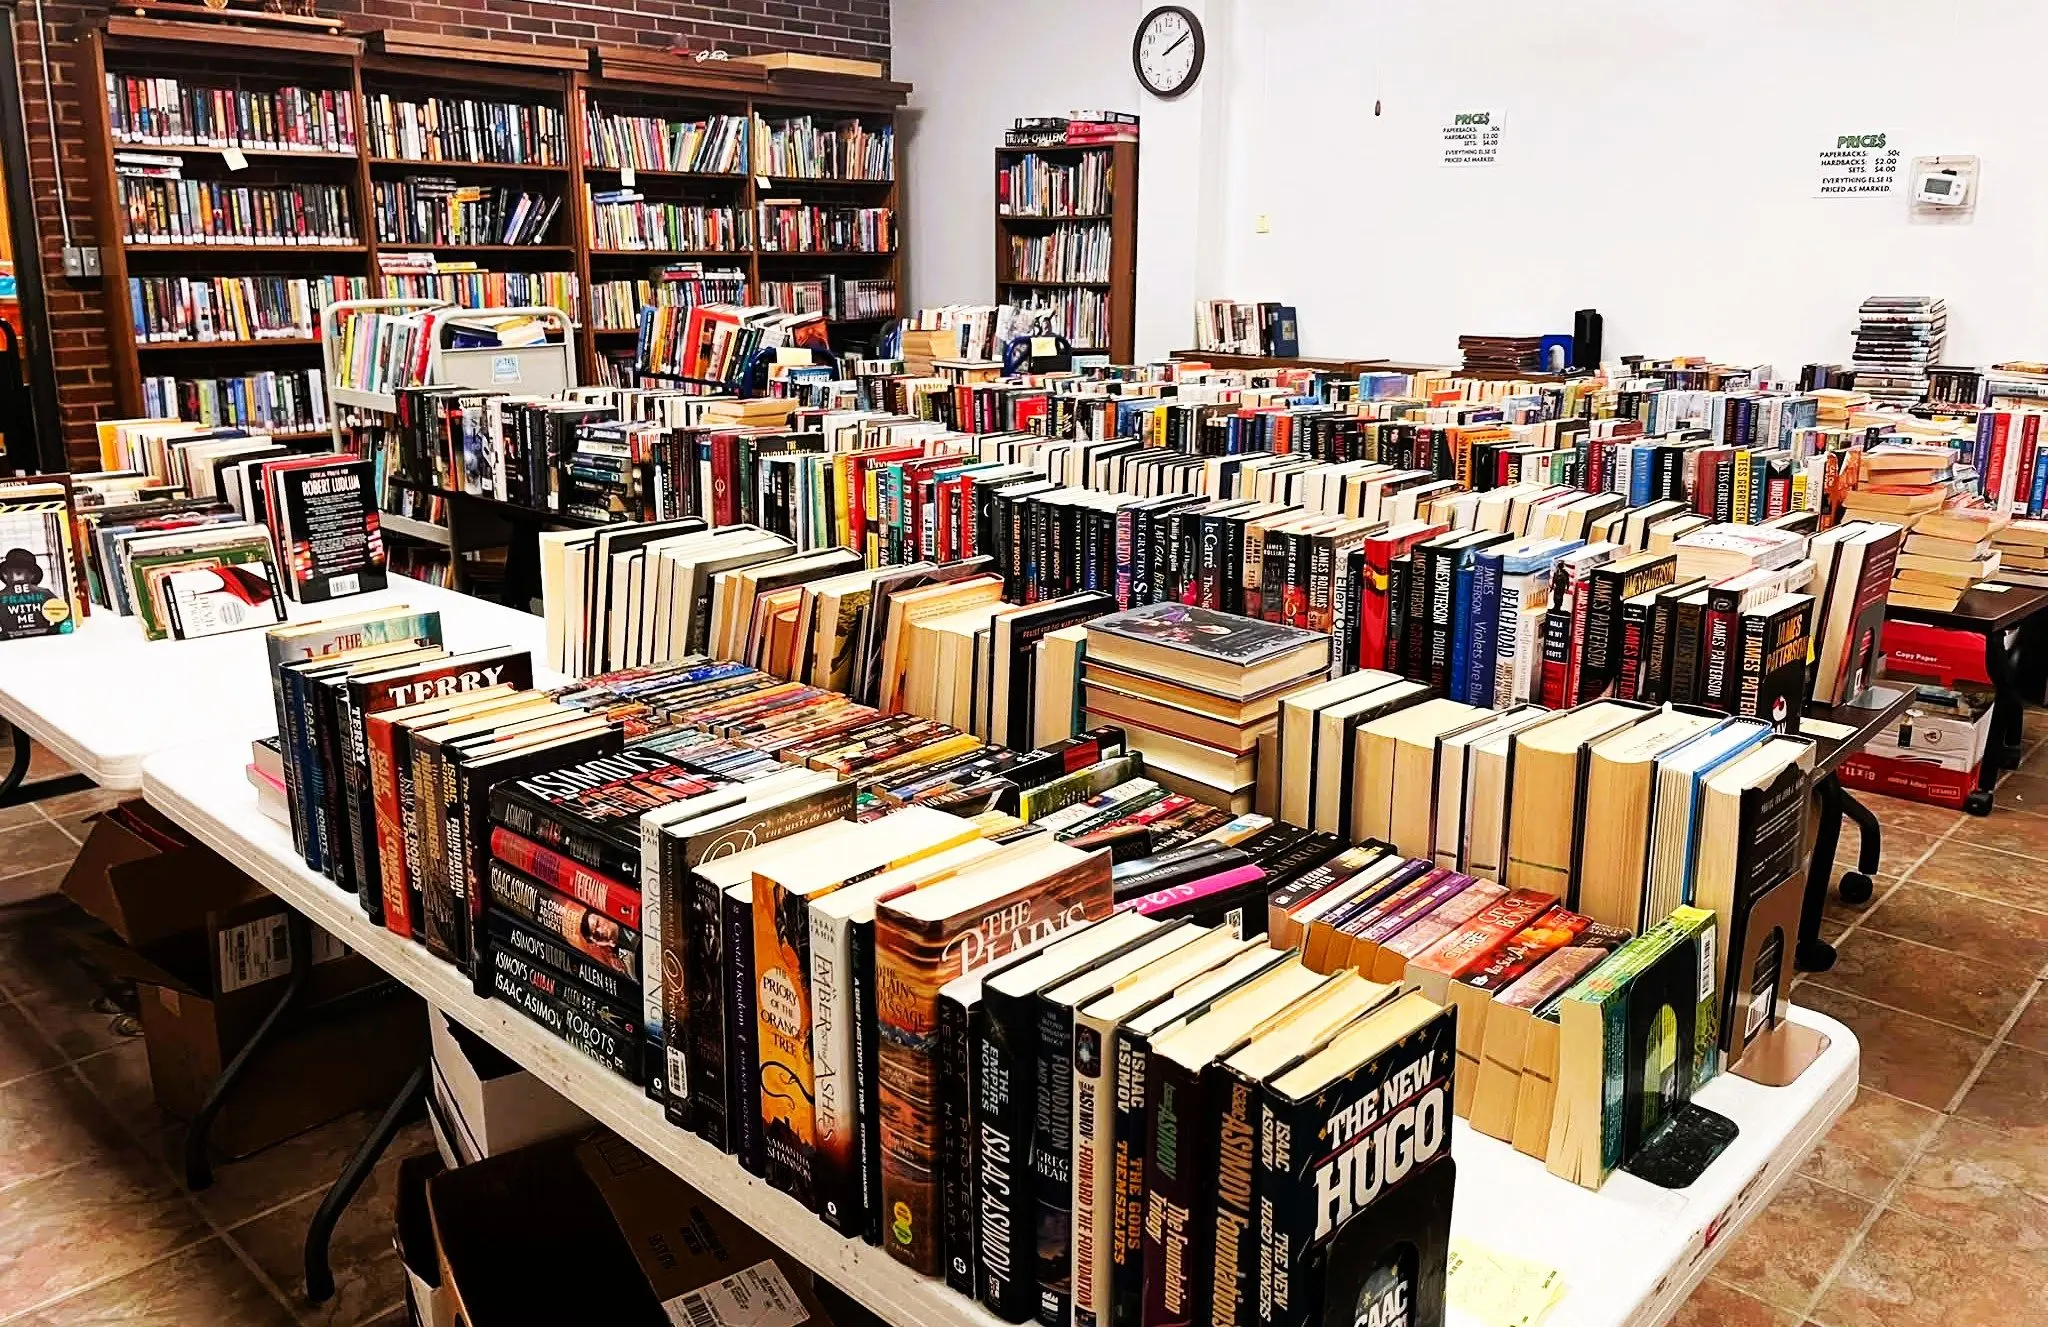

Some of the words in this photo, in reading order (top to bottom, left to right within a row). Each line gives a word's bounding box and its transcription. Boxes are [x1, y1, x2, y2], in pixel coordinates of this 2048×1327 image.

[302, 478, 331, 497] ROBERT
[332, 474, 362, 493] LUDLUM
[1458, 448, 1468, 482] HARLAN
[1737, 458, 1748, 477] TESS
[904, 498, 912, 534] ROBB
[1118, 510, 1132, 526] SUE
[1138, 512, 1146, 531] SUE
[1718, 482, 1729, 522] GERRITSEN
[1735, 479, 1748, 523] GERRITSEN
[1116, 526, 1131, 567] GRAFTON
[1154, 524, 1165, 546] LAST
[1204, 522, 1218, 533] le
[1136, 532, 1146, 580] GRAFTON
[1154, 545, 1164, 572] GIRL
[1204, 534, 1218, 569] Carré
[1253, 538, 1261, 564] JAMES
[1288, 537, 1297, 562] JAMES
[1318, 546, 1330, 573] JAMES
[1412, 550, 1427, 577] JAMES
[1436, 554, 1452, 581] JAMES
[14, 583, 30, 594] BE
[1248, 570, 1256, 588] THE
[1287, 562, 1296, 595] ROLLINS
[1316, 574, 1329, 609] ROLLINS
[1334, 576, 1347, 614] Ellery
[1348, 566, 1357, 601] Agent
[1410, 577, 1426, 618] PATTERSON
[1471, 565, 1484, 615] PATTERSON
[1482, 565, 1496, 596] JAMES
[1576, 588, 1589, 610] JAMES
[1594, 576, 1614, 610] JAMES
[8, 602, 42, 616] WITH
[17, 614, 35, 624] ME
[1432, 580, 1450, 625] PATTERSON
[1500, 588, 1520, 624] BEACH
[1656, 606, 1669, 634] JAMES
[334, 633, 362, 651] THE
[1332, 618, 1346, 663] Queen
[1432, 630, 1446, 666] DOUBLE
[1472, 620, 1488, 658] Violets
[1496, 625, 1518, 659] ROAD
[1546, 640, 1565, 649] COMBAT
[1587, 612, 1611, 668] PATTERSON
[1624, 622, 1641, 657] JAMES
[1712, 618, 1727, 647] JAMES
[1776, 614, 1802, 648] JAMES
[1471, 660, 1482, 682] Are
[1648, 635, 1666, 682] PATTERSON
[1708, 649, 1725, 698] PATTERSON
[1744, 636, 1763, 671] JAMES
[1766, 634, 1810, 675] PATTERSON
[1896, 650, 1915, 660] Copy
[1916, 653, 1938, 663] Paper
[389, 664, 504, 708] TERRY
[1739, 676, 1760, 718] PATTER
[351, 706, 366, 766] TERRY
[305, 702, 316, 748] ISAAC
[318, 806, 329, 857] ROBOTS
[448, 762, 458, 804] ISAAC
[406, 811, 418, 836] THE
[420, 750, 440, 860] DRAGONRIDERS
[765, 830, 782, 840] THE
[783, 822, 808, 836] MISTS
[818, 803, 854, 822] AVALON
[376, 752, 392, 798] ISAAC
[388, 832, 403, 917] COMPLETE
[408, 837, 423, 892] ROBOTS
[450, 816, 464, 899] FOUNDATION
[491, 866, 510, 896] ISAAC
[510, 880, 538, 912] ASIMOV
[645, 861, 662, 940] TORCH
[942, 901, 1086, 976] PLAINS
[982, 900, 1032, 940] THE
[510, 930, 544, 960] ASIMOV'S
[578, 964, 604, 988] ALLEN
[734, 922, 743, 971] Crystal
[495, 950, 528, 980] ASIMOV'S
[529, 969, 556, 996] CALIBAN
[564, 986, 582, 1006] ALLEN
[763, 976, 798, 1006] PRIORY
[814, 952, 834, 1034] EMBER
[877, 972, 916, 998] PLAINS
[495, 972, 522, 1002] ISAAC
[524, 994, 562, 1030] ASIMOV
[566, 1010, 616, 1056] ROBOTS
[735, 972, 744, 1028] Kingdom
[854, 988, 862, 1020] BRIEF
[878, 994, 926, 1028] PASSAGE
[772, 1034, 797, 1058] TREE
[856, 1022, 864, 1070] HISTORY
[941, 1002, 951, 1076] WEIR
[740, 1049, 748, 1092] AMANDA
[980, 1038, 990, 1112] NOVELS
[989, 1044, 1000, 1116] EMPIRE
[998, 1068, 1009, 1104] THE
[1037, 1058, 1049, 1084] AND
[1117, 1037, 1132, 1114] ASIMOV
[1131, 1050, 1146, 1108] ISAAC
[815, 1058, 836, 1142] ASHES
[1036, 1085, 1050, 1133] CHAOS
[1052, 1054, 1070, 1150] FOUNDATION
[1079, 1090, 1094, 1140] ASIMOV
[1327, 1091, 1378, 1151] THE
[1382, 1050, 1436, 1116] NEW
[741, 1098, 750, 1148] HOCKING
[944, 1102, 953, 1168] HAIL
[1260, 1103, 1274, 1172] ASIMOV
[766, 1134, 811, 1168] SAMANTHA
[766, 1148, 812, 1183] SHANNON
[982, 1122, 1010, 1196] ISAAC
[1036, 1148, 1068, 1172] GREG
[1218, 1112, 1254, 1212] ASIMOV
[1274, 1120, 1290, 1173] ISAAC
[1313, 1087, 1444, 1242] HUGO
[960, 1116, 971, 1242] PROJECT
[1036, 1160, 1068, 1184] BEAR
[1078, 1144, 1094, 1206] FORWARD
[1128, 1157, 1144, 1196] THE
[945, 1180, 956, 1242] MARY
[1078, 1206, 1094, 1232] THE
[1113, 1140, 1128, 1266] THEMSELVES
[1146, 1188, 1167, 1244] Trilogy
[1168, 1202, 1190, 1229] The
[1260, 1196, 1273, 1244] HUGO
[982, 1196, 1010, 1282] ASIMOV
[1128, 1203, 1142, 1250] GODS
[1164, 1227, 1188, 1314] Foundation
[1274, 1232, 1289, 1268] THE
[1076, 1232, 1094, 1310] FOUNDATION
[1259, 1242, 1272, 1322] WINNERS
[1274, 1266, 1289, 1311] NEW
